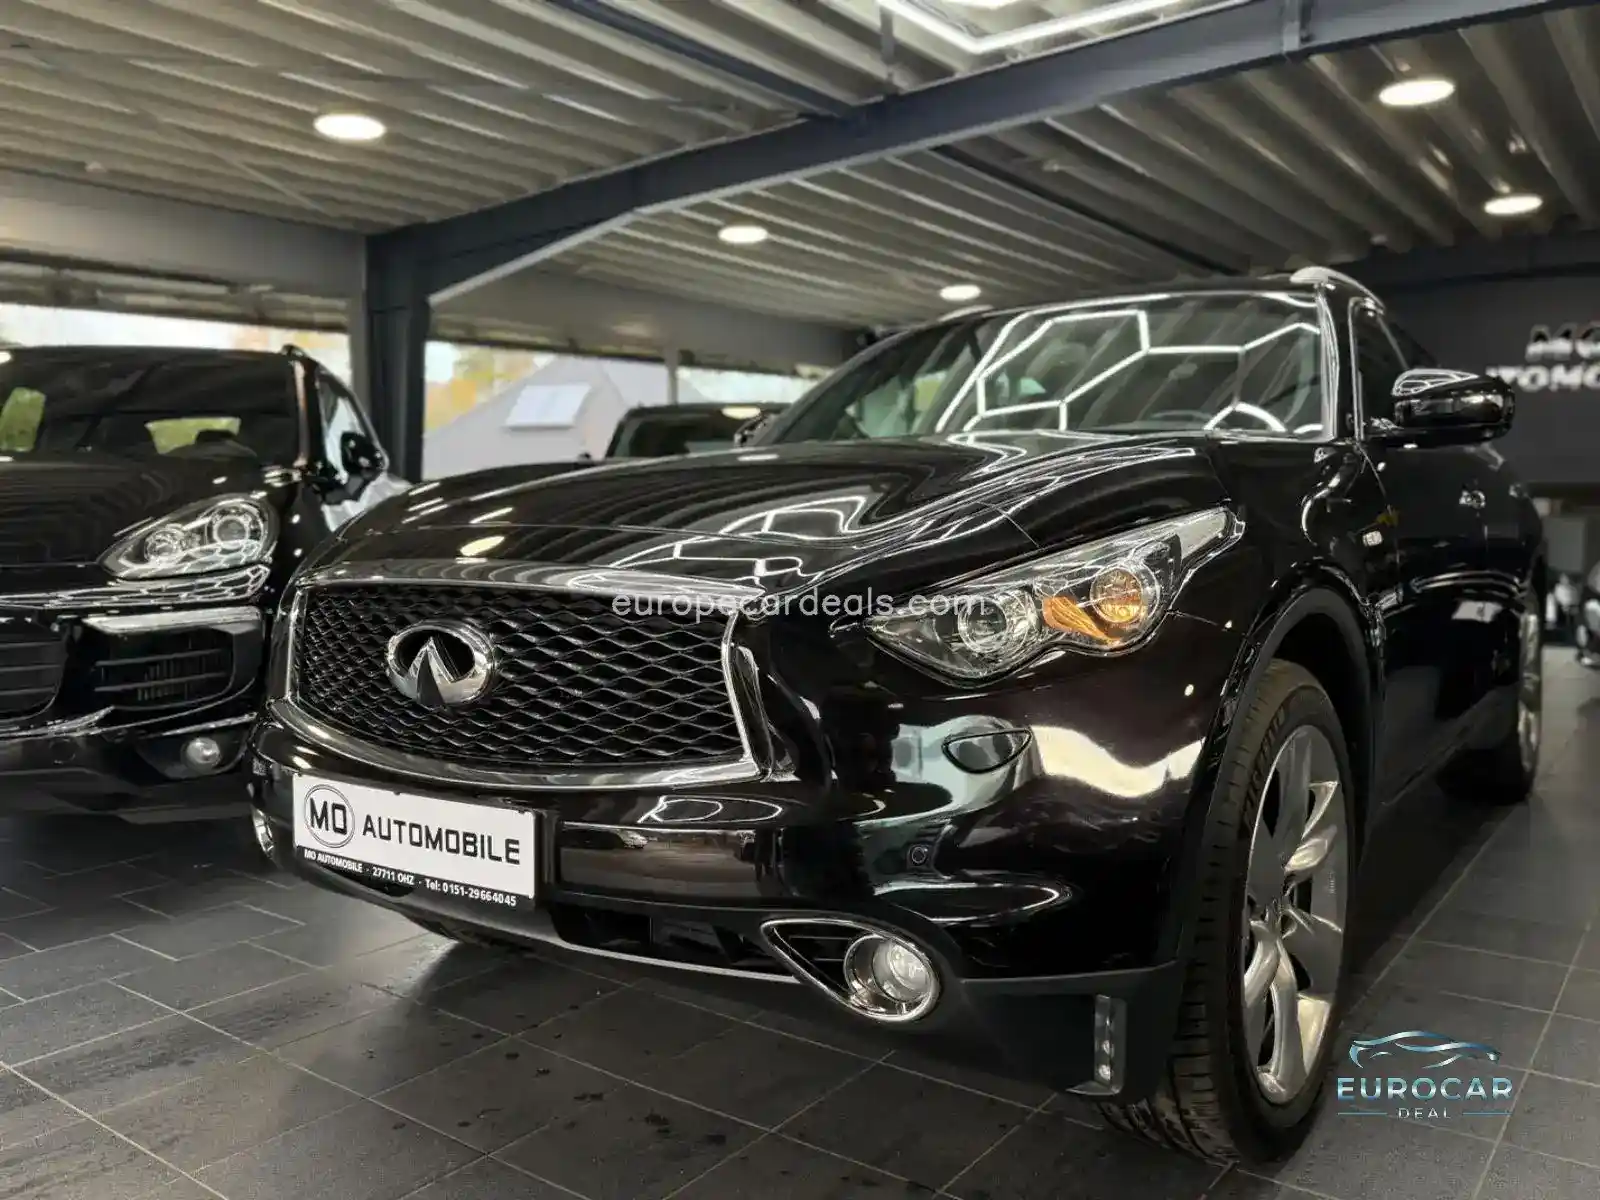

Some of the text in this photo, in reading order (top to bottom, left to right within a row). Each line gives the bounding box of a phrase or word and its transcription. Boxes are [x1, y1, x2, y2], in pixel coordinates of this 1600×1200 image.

[309, 797, 520, 866] MO AUTOMOBILE
[304, 849, 517, 907] MO AUTOMOBILE 27711 OHZ Tel: 0151-29664045
